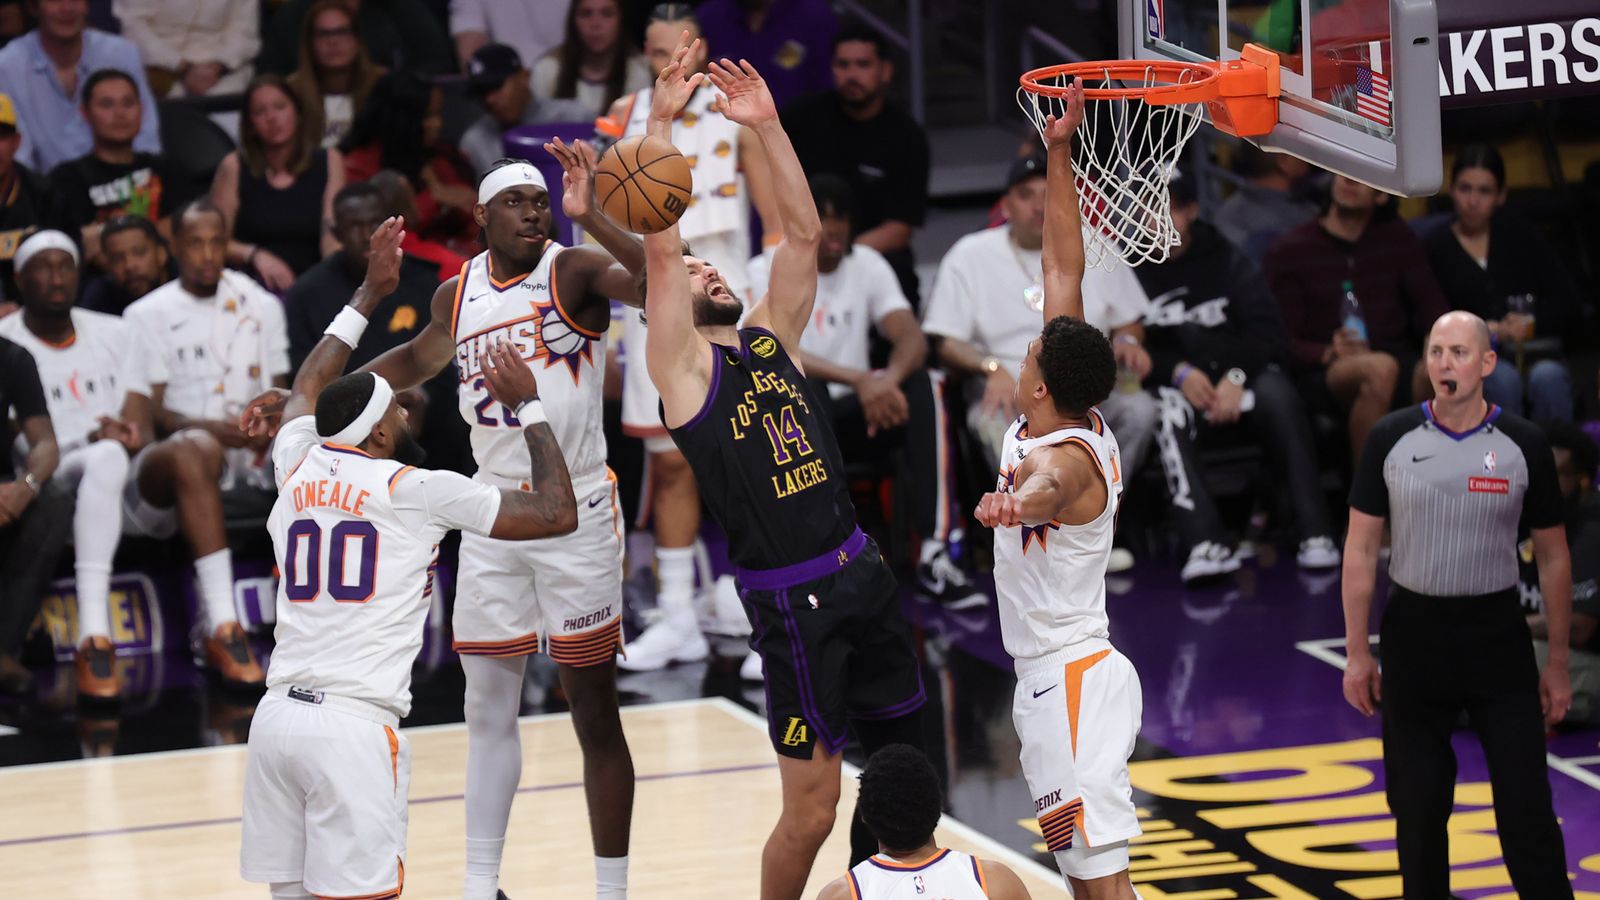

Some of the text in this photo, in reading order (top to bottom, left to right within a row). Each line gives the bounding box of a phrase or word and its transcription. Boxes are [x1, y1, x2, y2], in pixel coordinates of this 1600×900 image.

[729, 390, 758, 440] LOS
[762, 404, 814, 466] 14
[292, 479, 370, 517] O'NEALE
[772, 458, 828, 499] LAKERS
[1470, 479, 1508, 491] Emirates
[285, 519, 380, 604] 00
[563, 603, 612, 632] PHOENIX
[783, 716, 809, 747] LA
